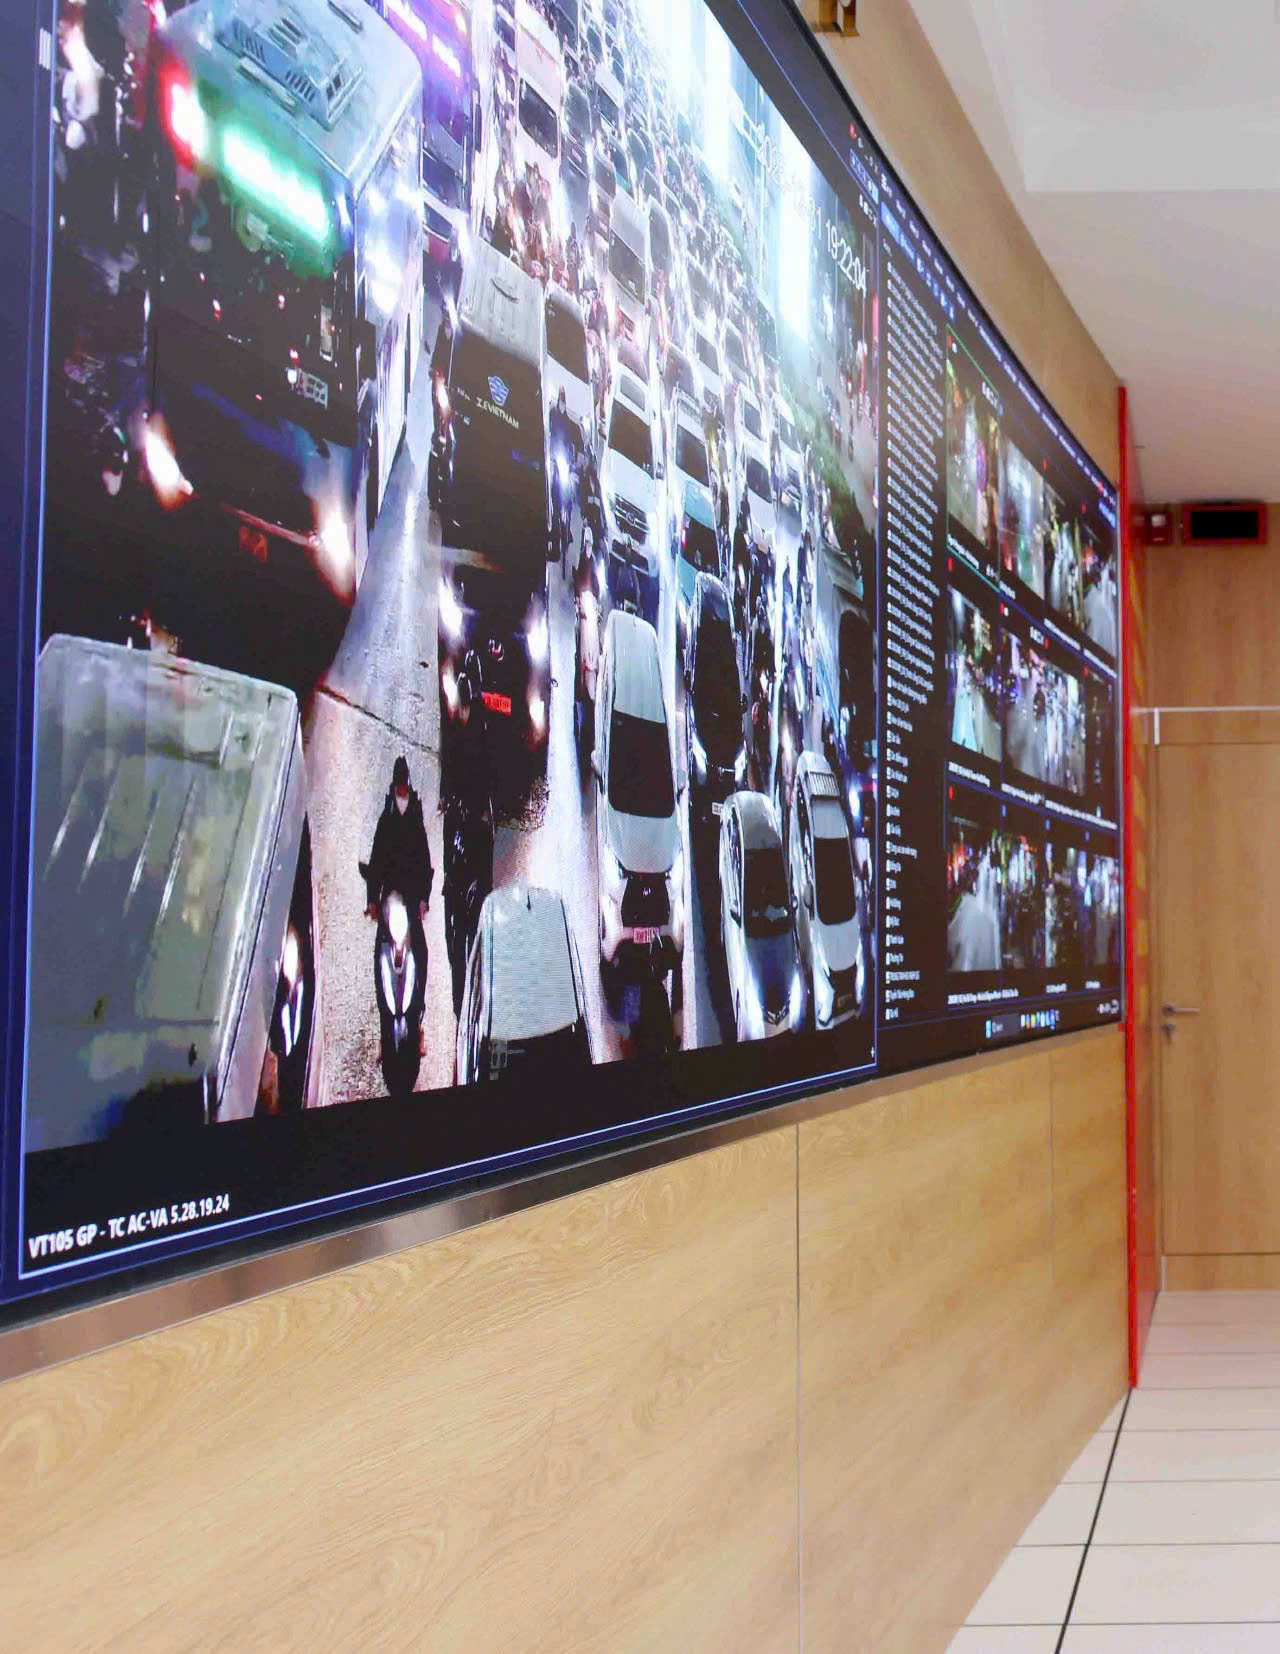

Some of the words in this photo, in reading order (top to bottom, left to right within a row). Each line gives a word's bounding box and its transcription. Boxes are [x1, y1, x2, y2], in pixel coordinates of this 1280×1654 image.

[28, 1228, 74, 1259] VT105
[76, 1223, 97, 1246] GP
[108, 1216, 126, 1239] TC
[127, 1205, 168, 1235] AC-VA
[170, 1193, 230, 1224] 5.28.19.24
